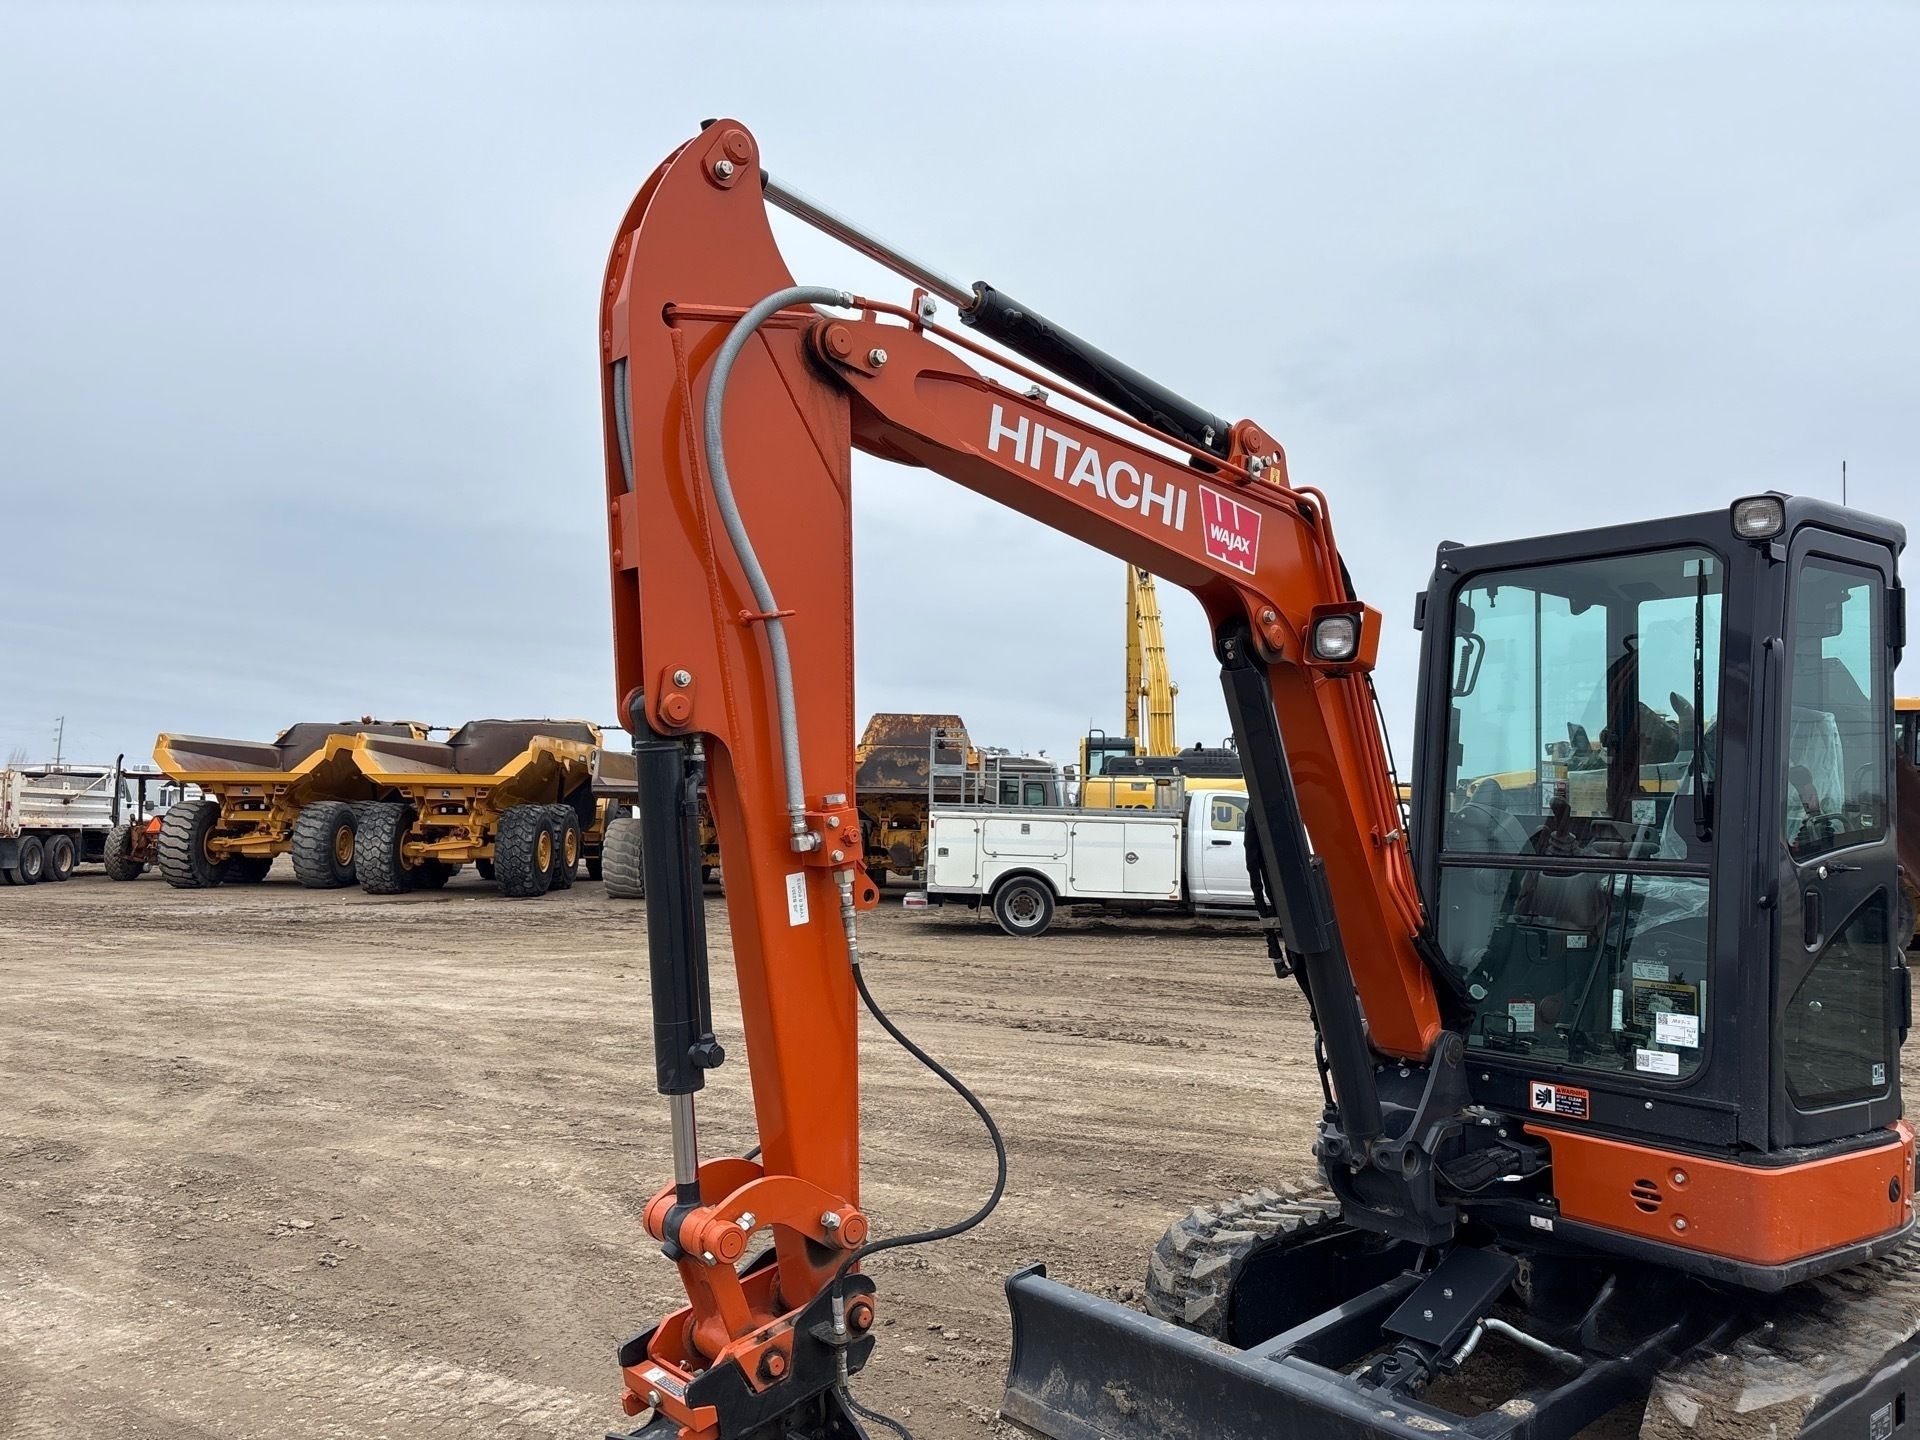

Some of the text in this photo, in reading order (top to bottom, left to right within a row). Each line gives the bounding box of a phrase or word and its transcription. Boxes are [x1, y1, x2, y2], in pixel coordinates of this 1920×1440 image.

[988, 404, 1187, 531] HITACHI
[1210, 523, 1250, 555] WAJAX
[1561, 1088, 1586, 1097] WARNING
